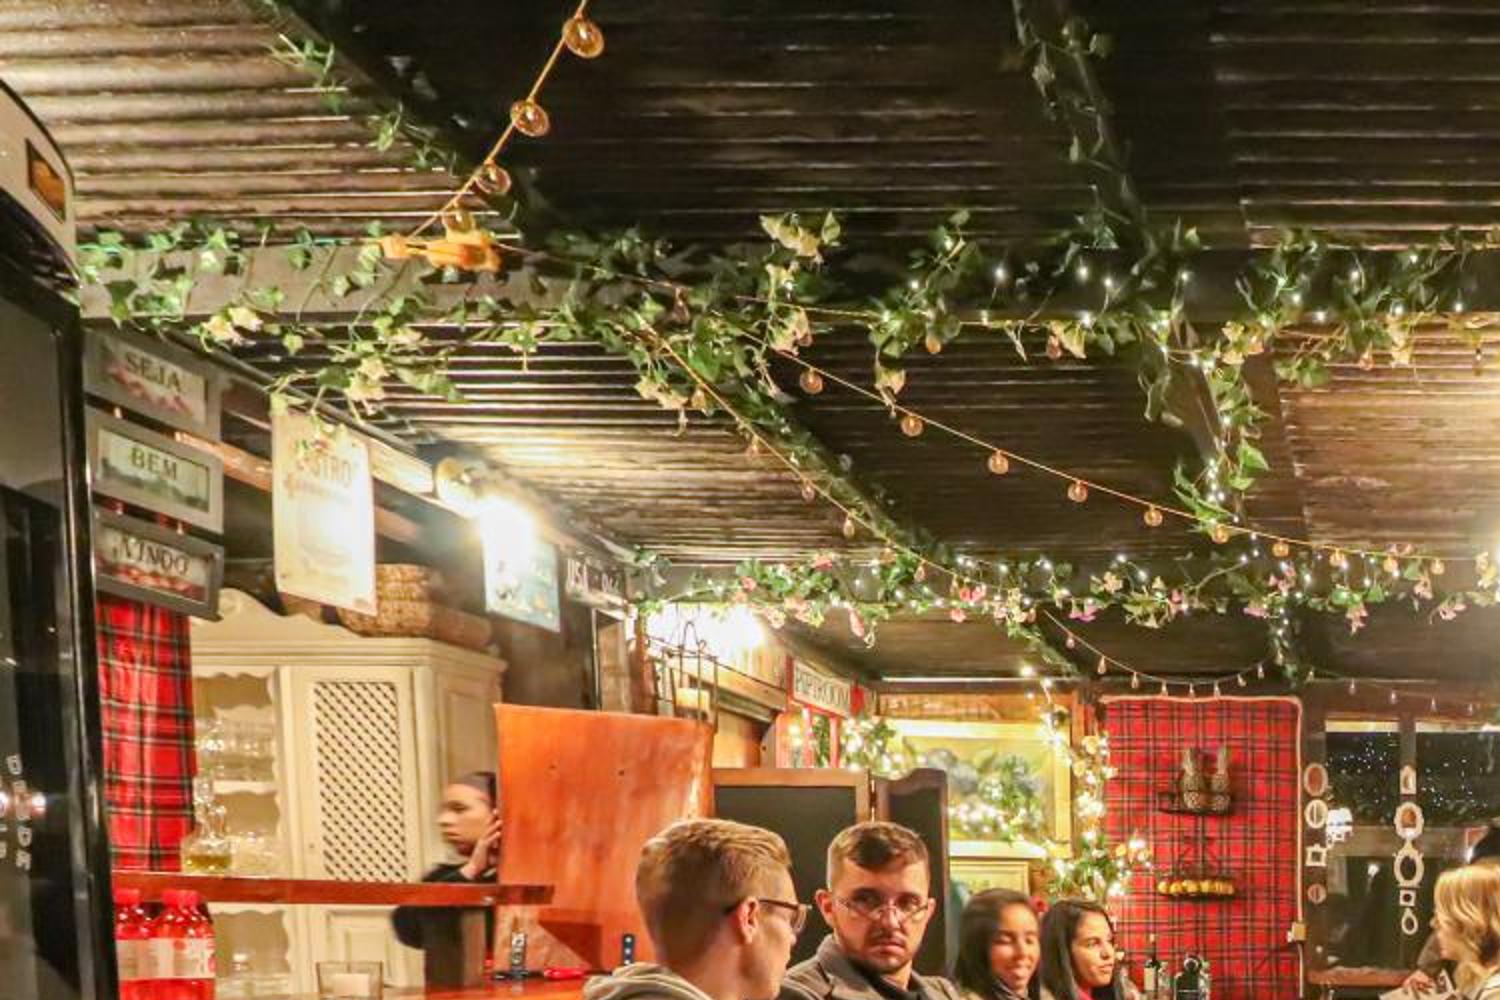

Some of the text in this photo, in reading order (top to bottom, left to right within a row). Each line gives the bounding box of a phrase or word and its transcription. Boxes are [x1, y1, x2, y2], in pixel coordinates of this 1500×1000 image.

[126, 350, 181, 392] SEJA
[131, 447, 177, 480] BEM
[119, 533, 189, 576] VINDO
